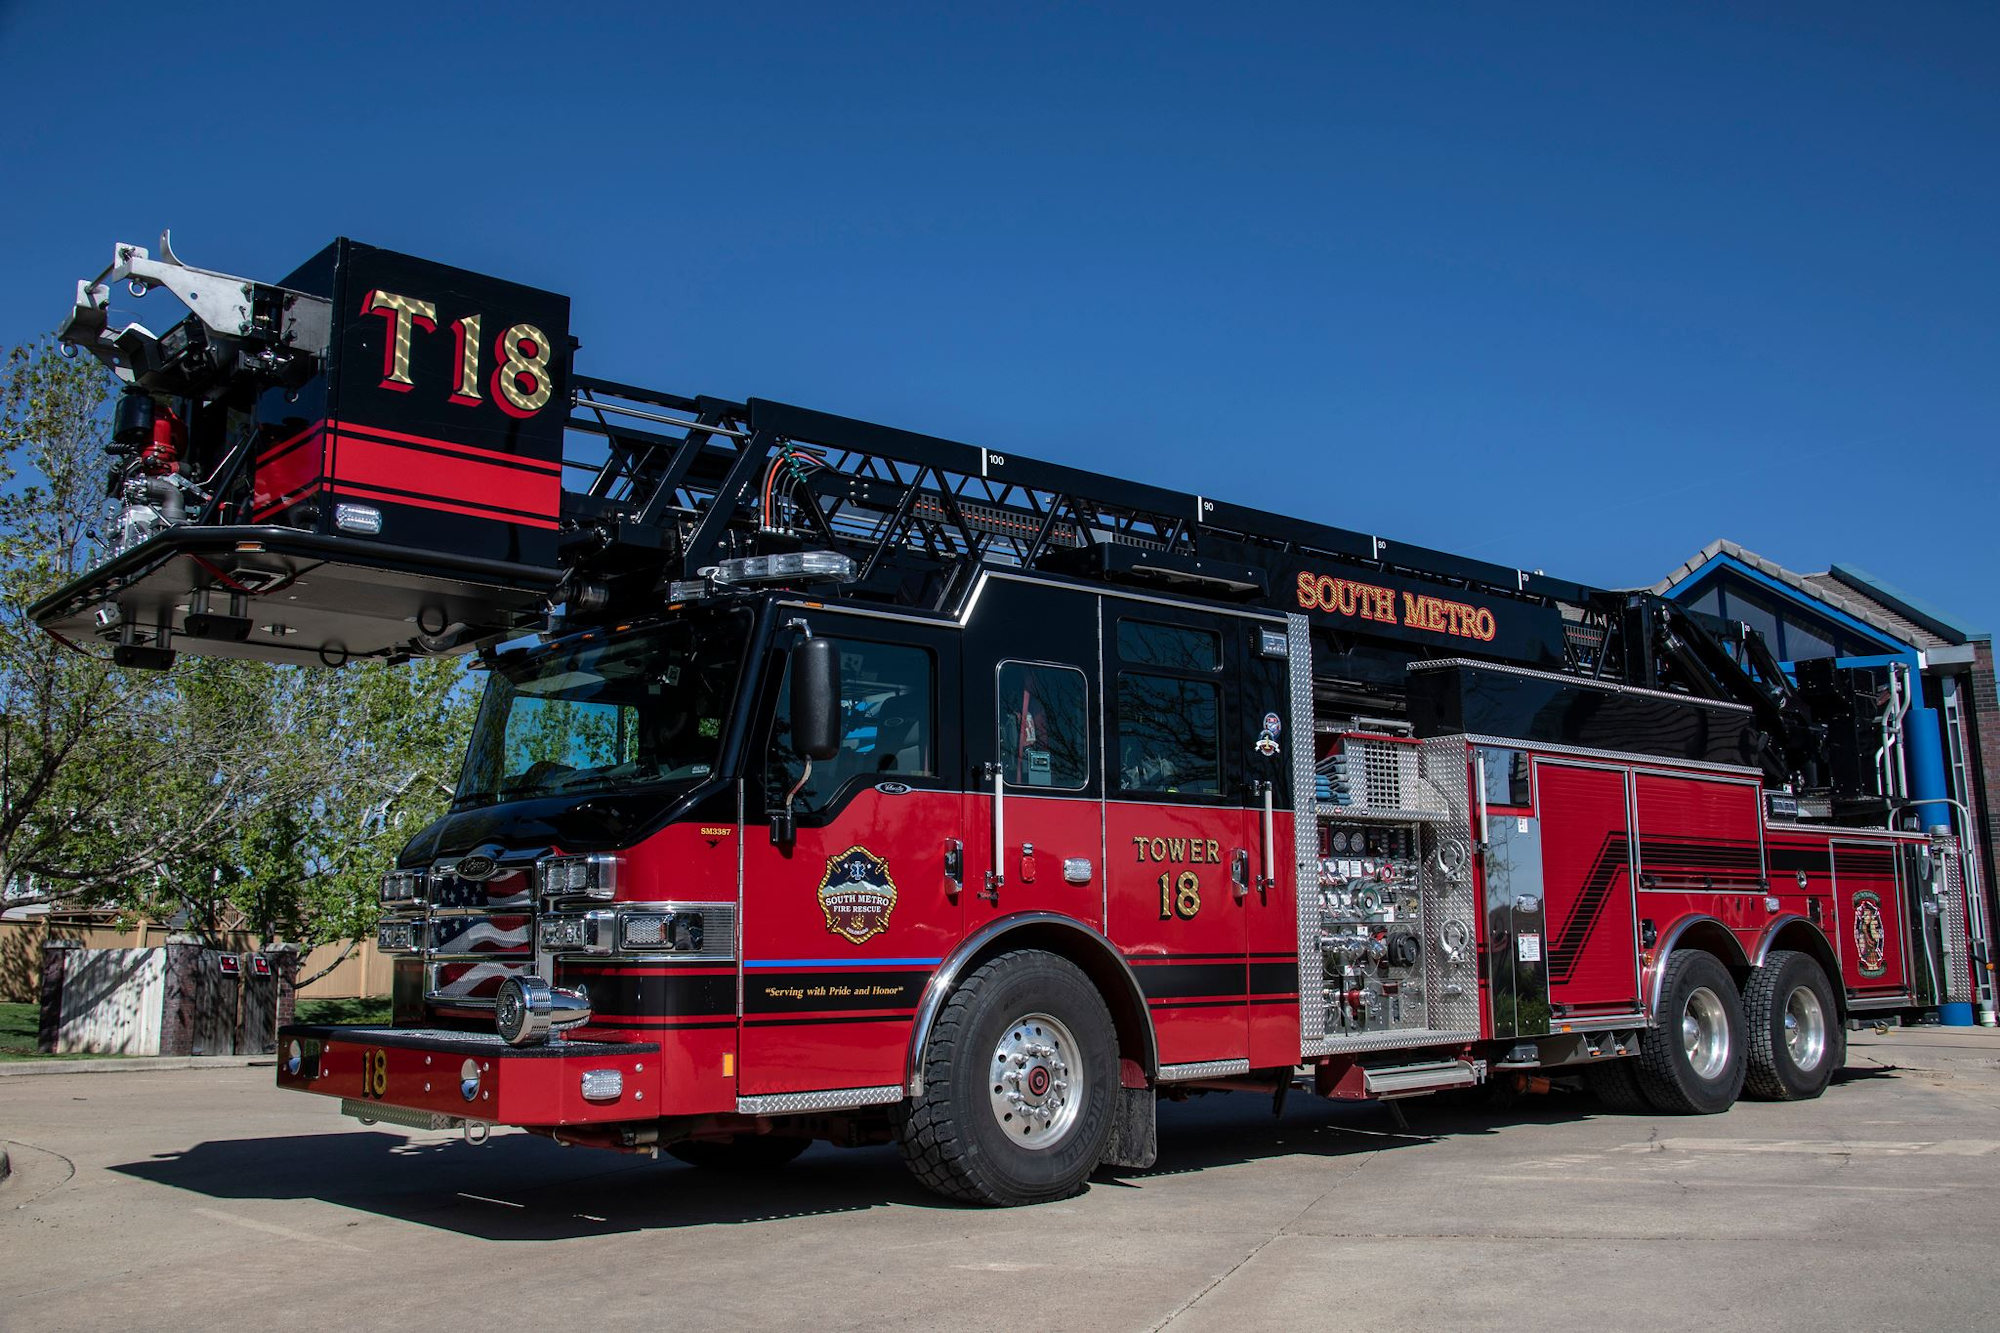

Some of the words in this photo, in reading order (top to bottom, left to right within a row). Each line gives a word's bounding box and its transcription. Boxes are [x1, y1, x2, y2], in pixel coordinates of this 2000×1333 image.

[359, 288, 552, 419] T18
[989, 454, 1005, 466] 100
[1203, 501, 1214, 512] 90
[1377, 540, 1387, 550] 80
[1521, 573, 1530, 582] 70
[1296, 570, 1398, 624] SOUTH
[1402, 591, 1497, 642] METRO
[700, 827, 732, 836] SM3387
[1133, 836, 1221, 864] TOWER
[825, 894, 856, 906] SOUTH
[857, 894, 889, 906] METRO
[1158, 870, 1201, 921] 18
[833, 905, 851, 913] FIRE
[852, 905, 881, 913] RESCUE
[806, 986, 827, 996] with
[829, 985, 851, 996] Pride
[853, 986, 870, 995] and
[362, 1047, 387, 1099] 18
